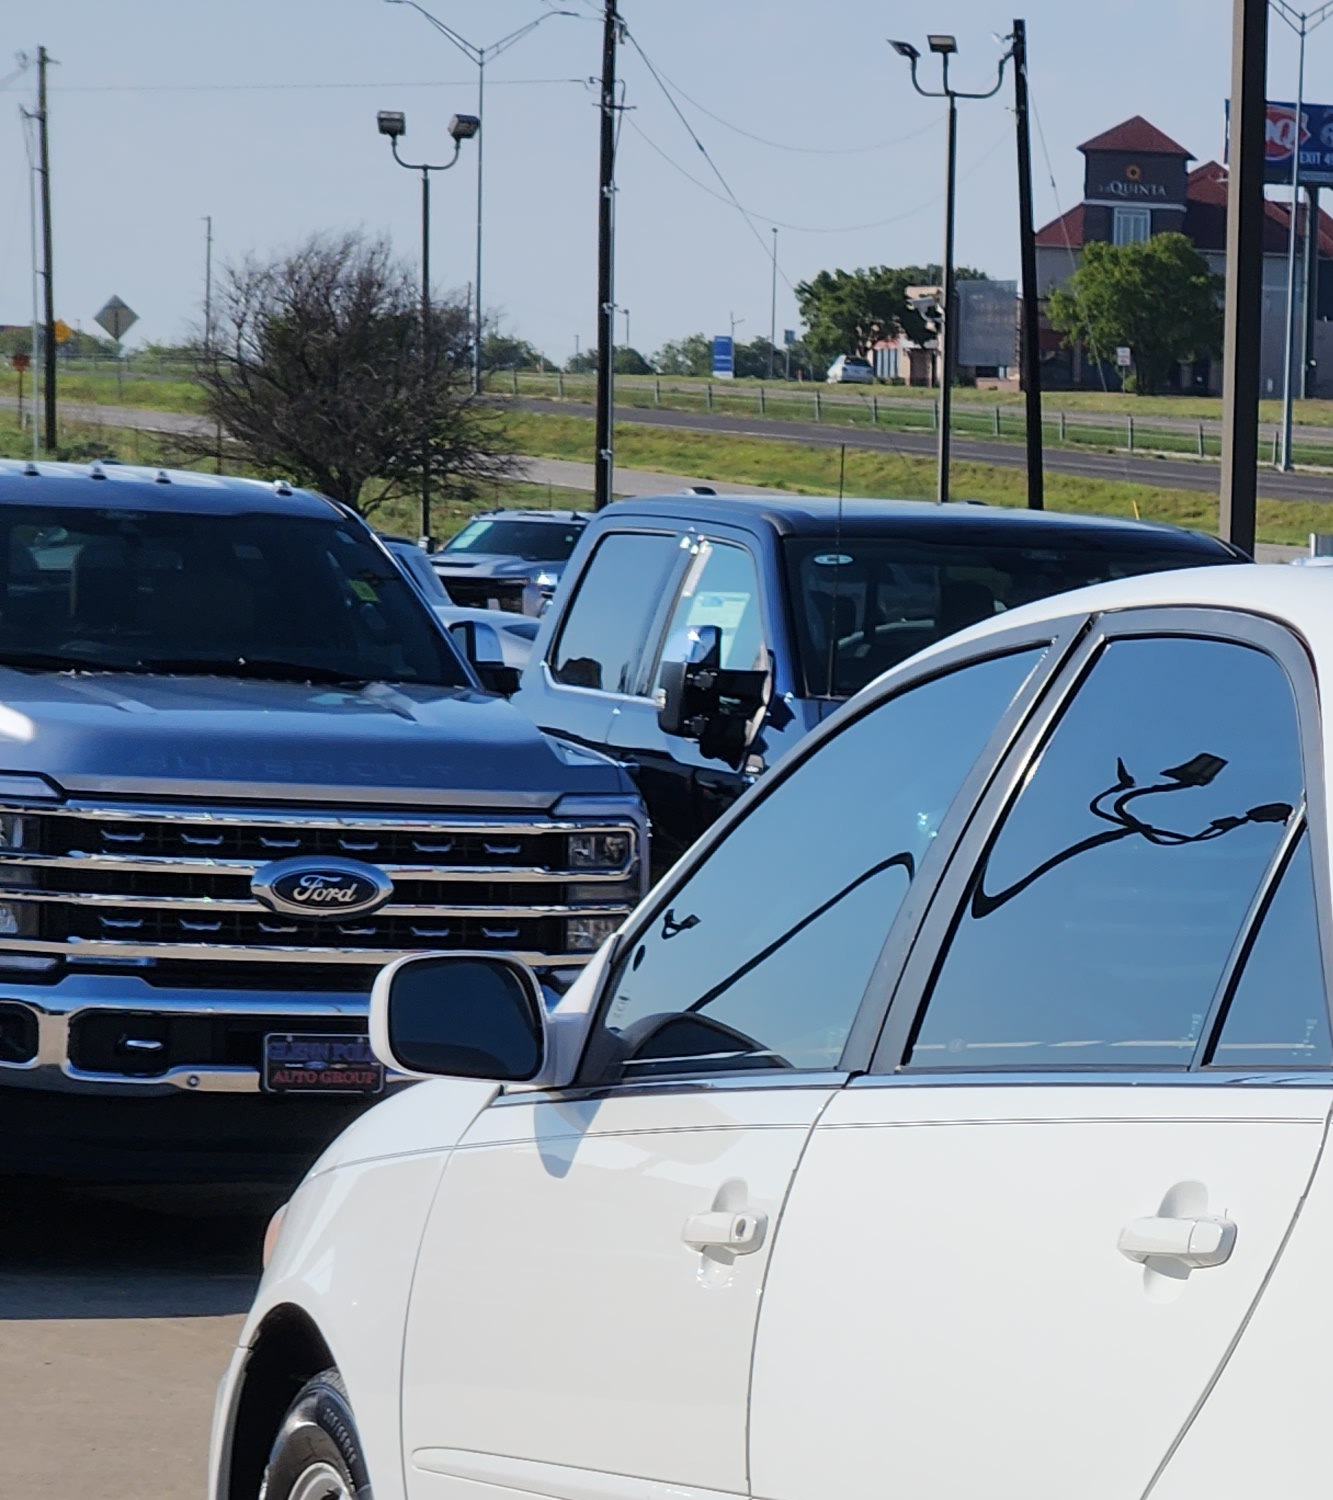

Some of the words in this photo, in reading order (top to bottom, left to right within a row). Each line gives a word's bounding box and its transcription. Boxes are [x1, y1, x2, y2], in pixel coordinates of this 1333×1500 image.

[1299, 151, 1321, 166] EXIT
[1110, 181, 1166, 197] QUINTA
[293, 874, 359, 903] Ford
[272, 1070, 318, 1083] AUTO
[319, 1070, 378, 1084] GROUP
